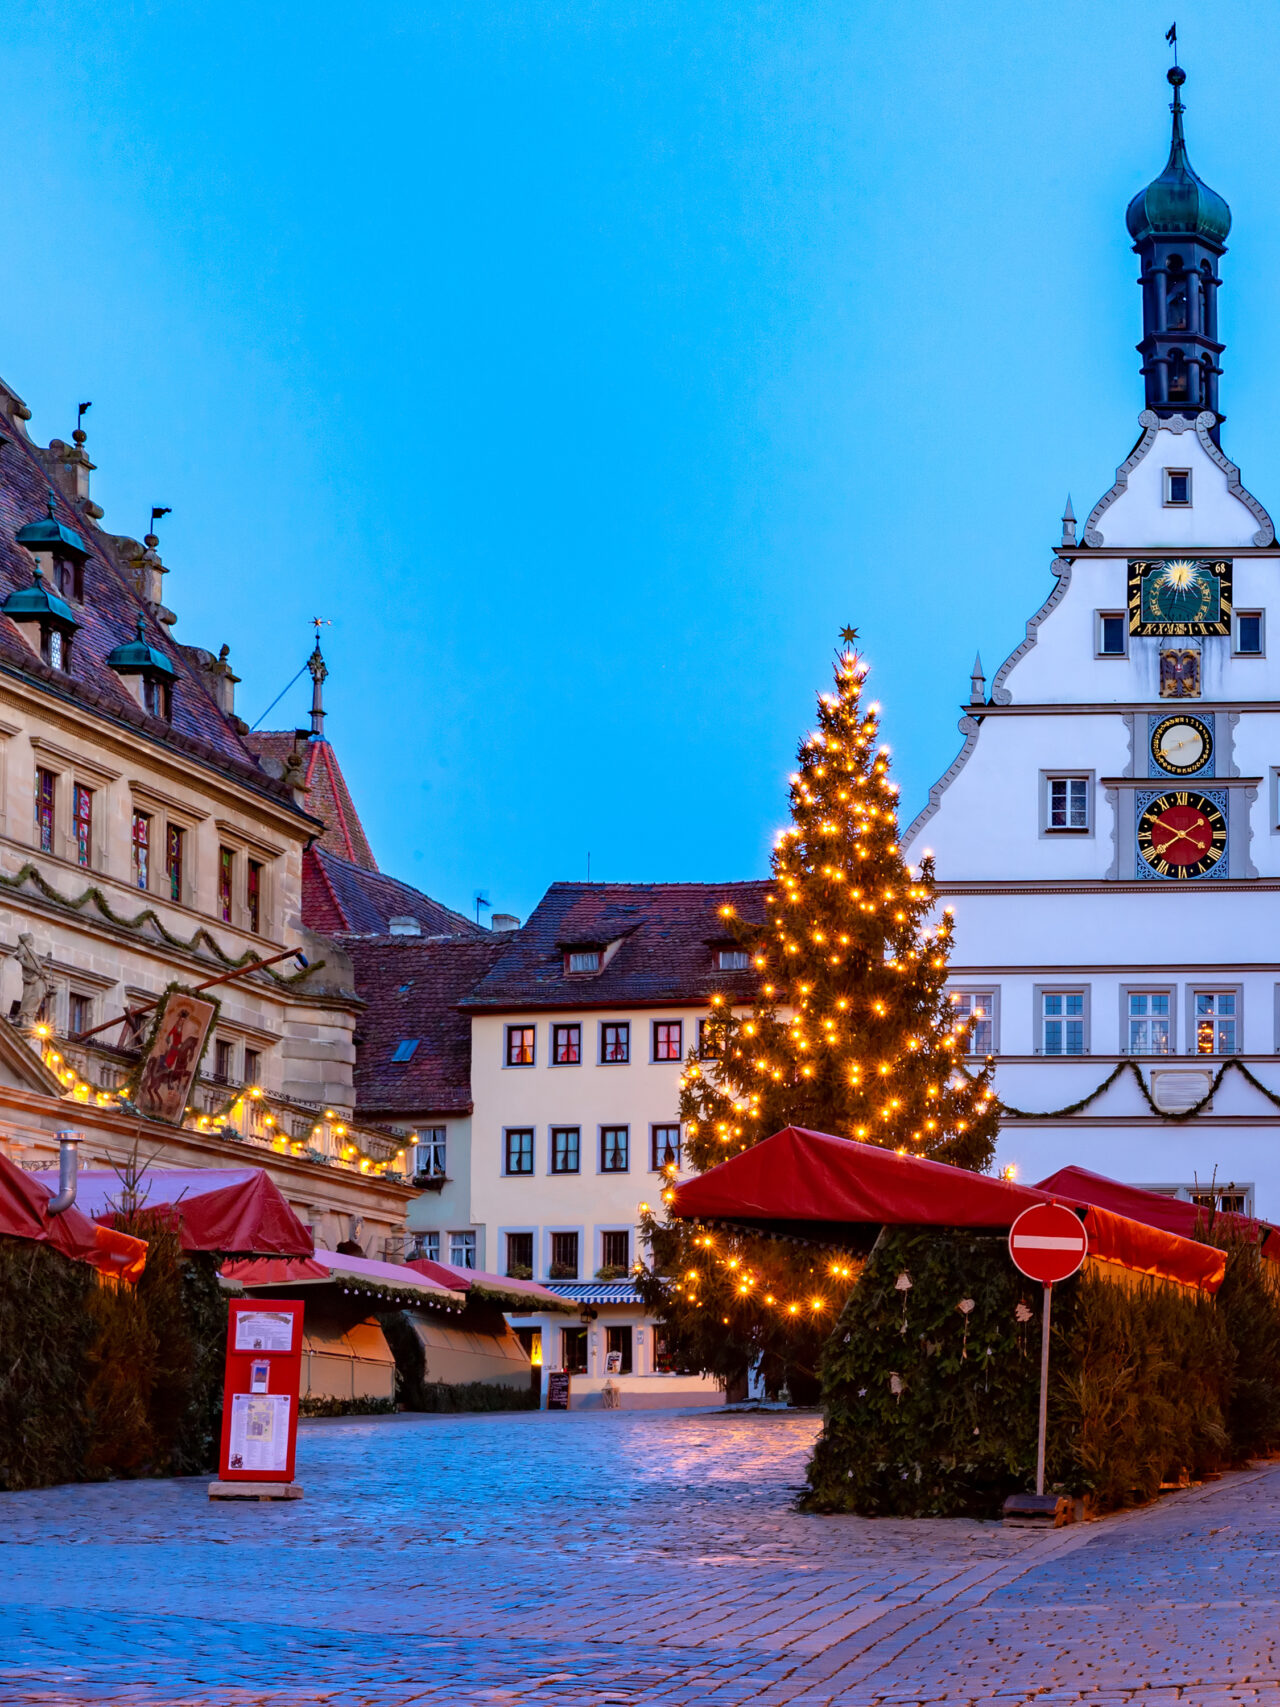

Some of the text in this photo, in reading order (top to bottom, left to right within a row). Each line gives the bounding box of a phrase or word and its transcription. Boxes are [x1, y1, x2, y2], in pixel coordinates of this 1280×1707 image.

[1134, 562, 1226, 574] 17 68
[1156, 796, 1170, 812] XI
[1175, 791, 1188, 806] XII
[1207, 811, 1222, 822] II
[1212, 830, 1227, 840] III
[1178, 865, 1188, 879] VI
[1196, 861, 1207, 874] V
